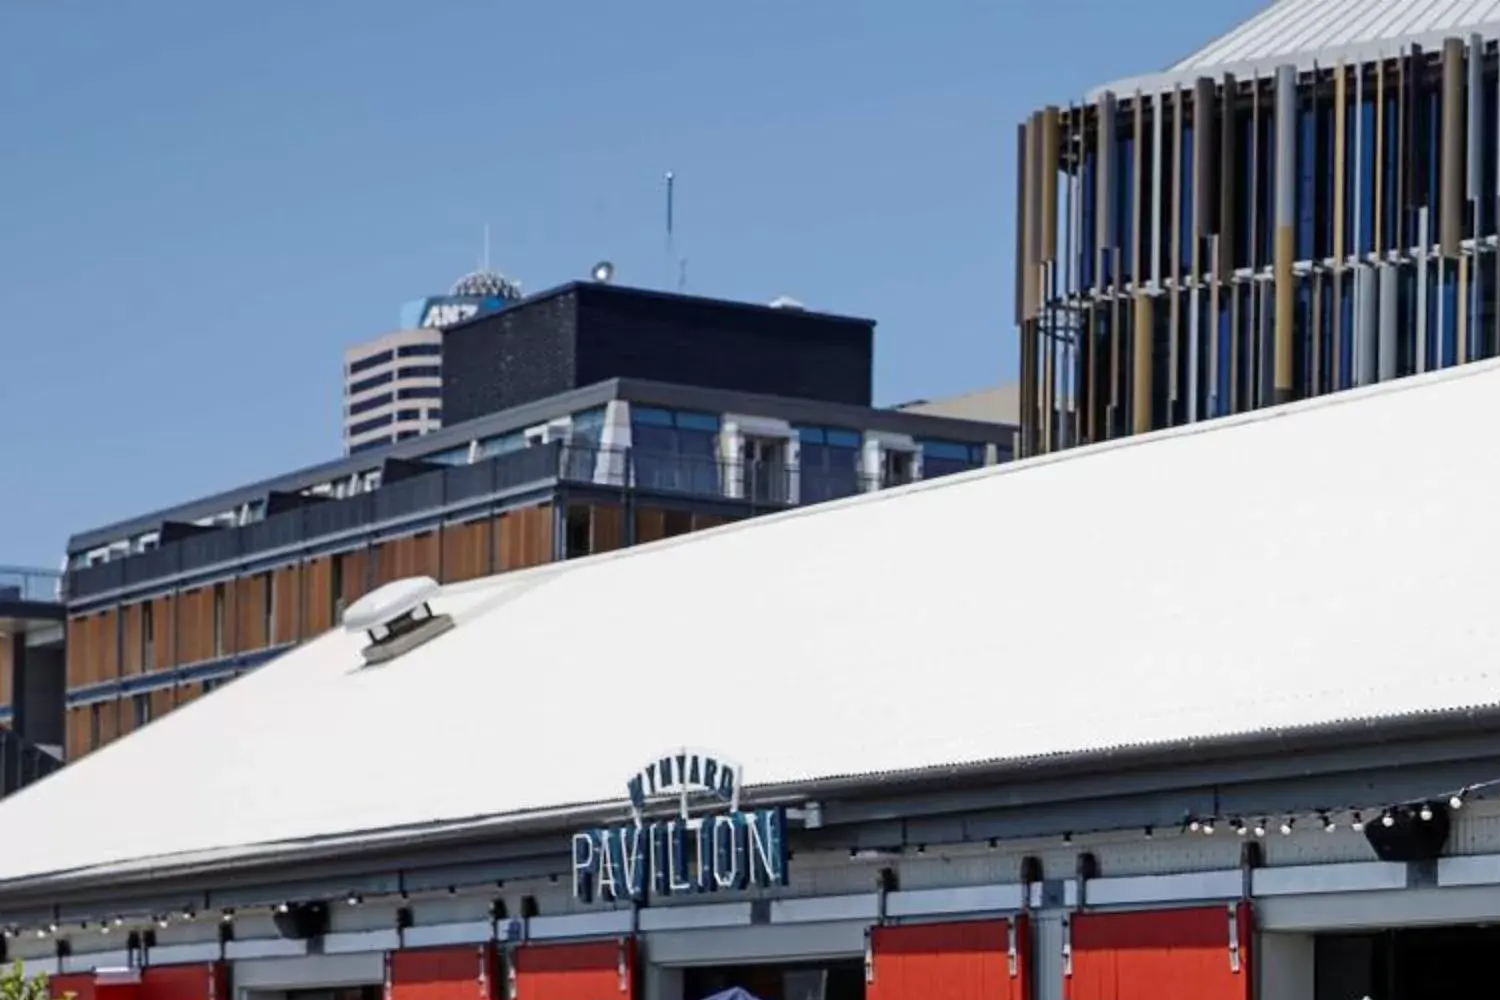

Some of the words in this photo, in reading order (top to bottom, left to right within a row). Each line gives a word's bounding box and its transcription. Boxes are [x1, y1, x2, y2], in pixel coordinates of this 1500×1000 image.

[423, 304, 478, 327] ANZ
[627, 755, 734, 807] WYNYARD
[571, 808, 787, 900] PAVILION
